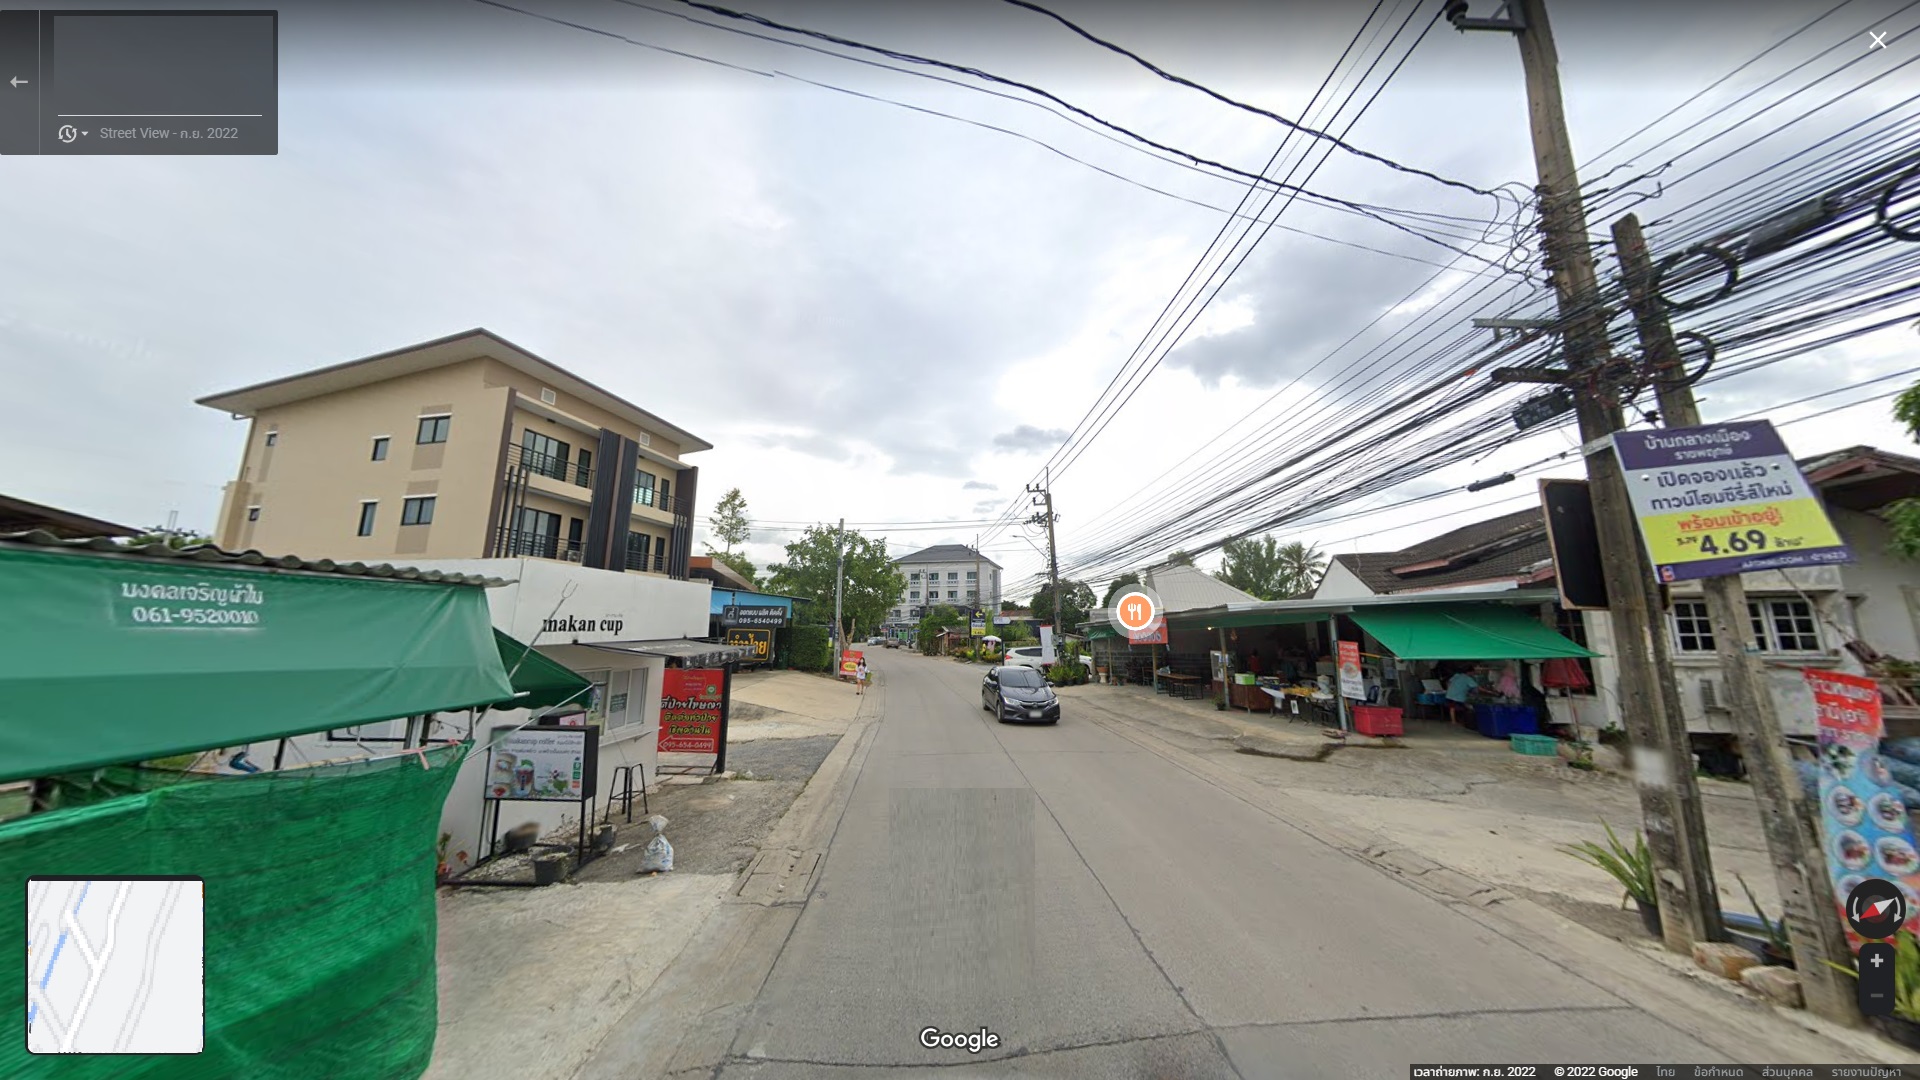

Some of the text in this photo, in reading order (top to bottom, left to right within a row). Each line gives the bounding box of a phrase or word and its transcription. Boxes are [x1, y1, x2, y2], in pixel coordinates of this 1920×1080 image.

[1644, 428, 1752, 450] บ้านกลางเมือง
[1657, 461, 1767, 488] เปิดจองแล้ว
[1700, 529, 1767, 556] 4.69
[132, 607, 260, 625] 061-9520010
[542, 615, 623, 635] makan cup
